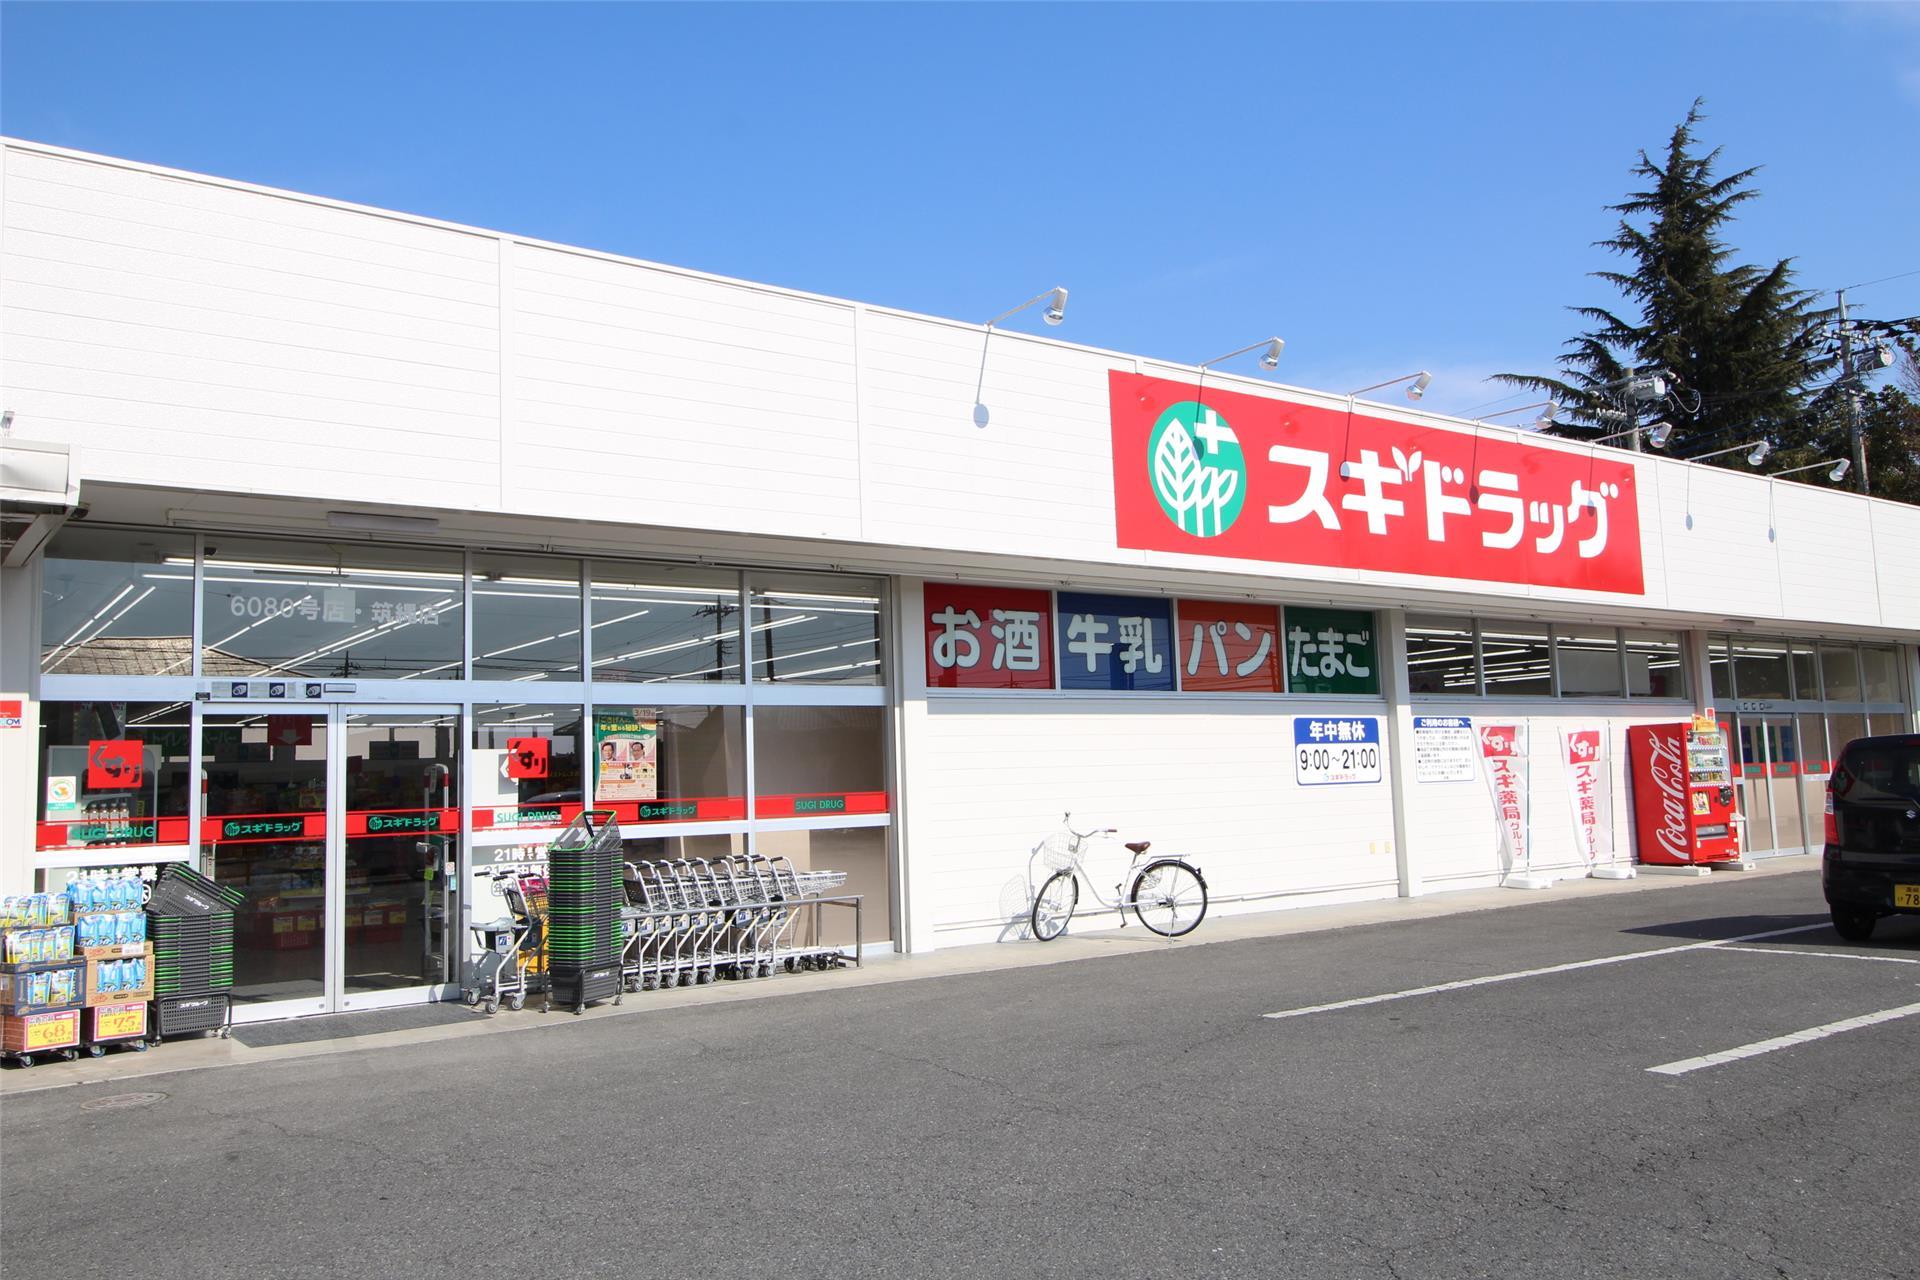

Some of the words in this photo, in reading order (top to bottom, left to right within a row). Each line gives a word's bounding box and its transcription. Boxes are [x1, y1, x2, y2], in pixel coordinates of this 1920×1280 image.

[1268, 443, 1619, 559] スギドラッグ
[931, 605, 1041, 671] お酒
[1067, 613, 1163, 674] 牛乳
[1187, 619, 1272, 677] パン
[1288, 625, 1371, 678] たまご
[1309, 720, 1366, 742] 年中無休
[1481, 727, 1517, 756] くすり
[1568, 733, 1600, 761] くすり
[795, 801, 817, 810] SUGI
[819, 799, 845, 809] DRUG
[1647, 729, 1690, 861] Coca-Cola
[382, 816, 438, 829] スギドラッグ
[496, 811, 525, 823] SUGI
[651, 804, 697, 816] スギドラッグ
[240, 821, 303, 834] スギドラッグ
